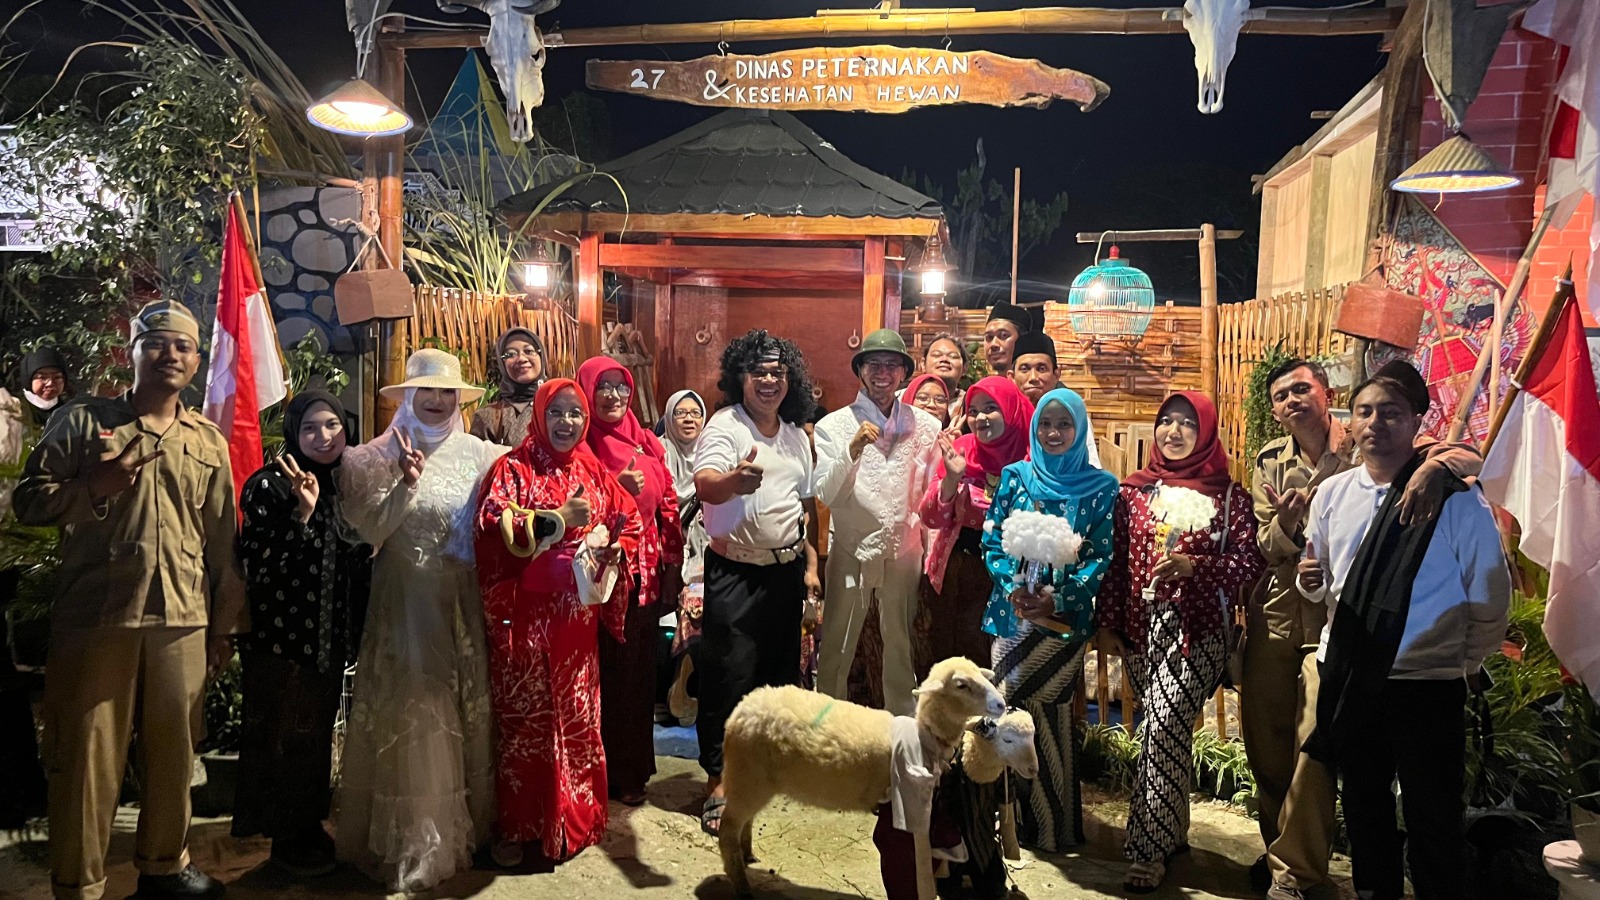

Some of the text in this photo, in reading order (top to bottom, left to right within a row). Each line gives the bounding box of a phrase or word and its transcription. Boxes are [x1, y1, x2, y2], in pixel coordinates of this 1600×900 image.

[630, 68, 666, 90] 27
[735, 55, 969, 79] DINAS PETERNAKAN
[703, 69, 961, 104] & KESEHATAN HEWAN
